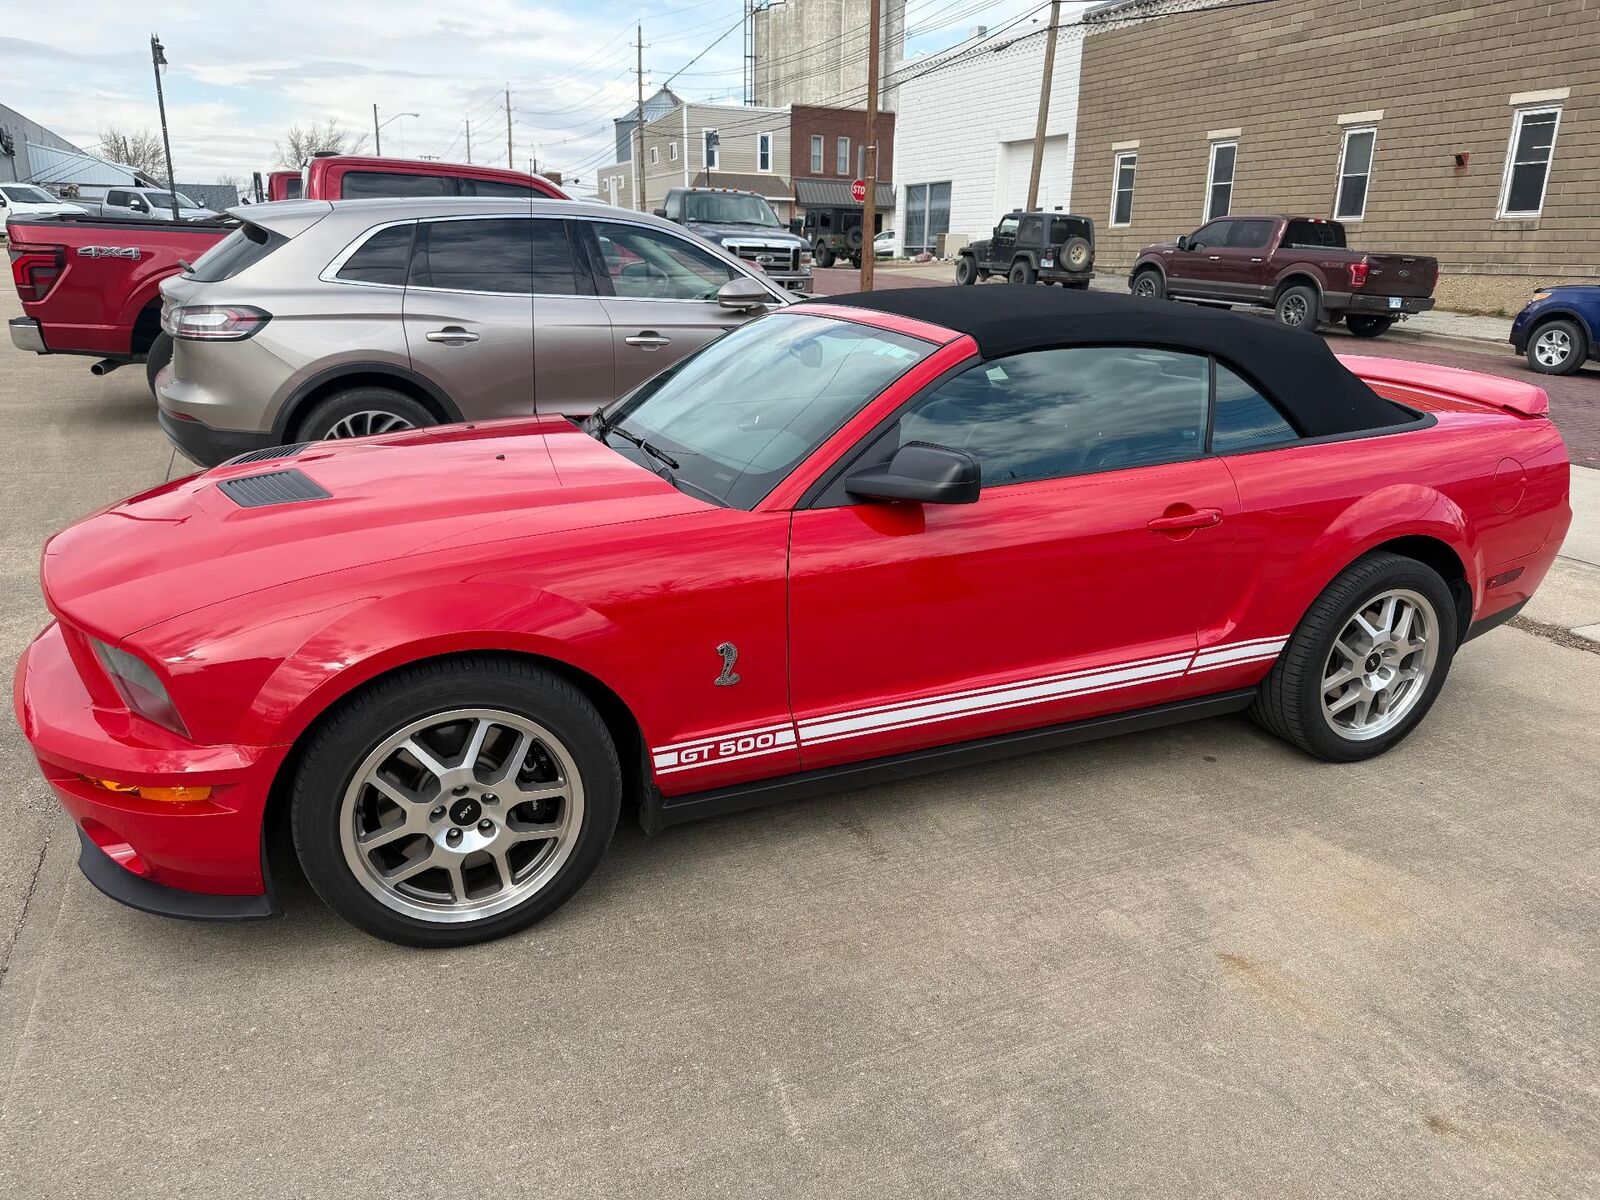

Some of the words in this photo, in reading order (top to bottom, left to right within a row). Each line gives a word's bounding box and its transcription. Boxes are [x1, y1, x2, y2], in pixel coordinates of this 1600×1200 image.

[852, 185, 866, 195] STO
[680, 744, 715, 763] GT
[719, 734, 774, 756] 500
